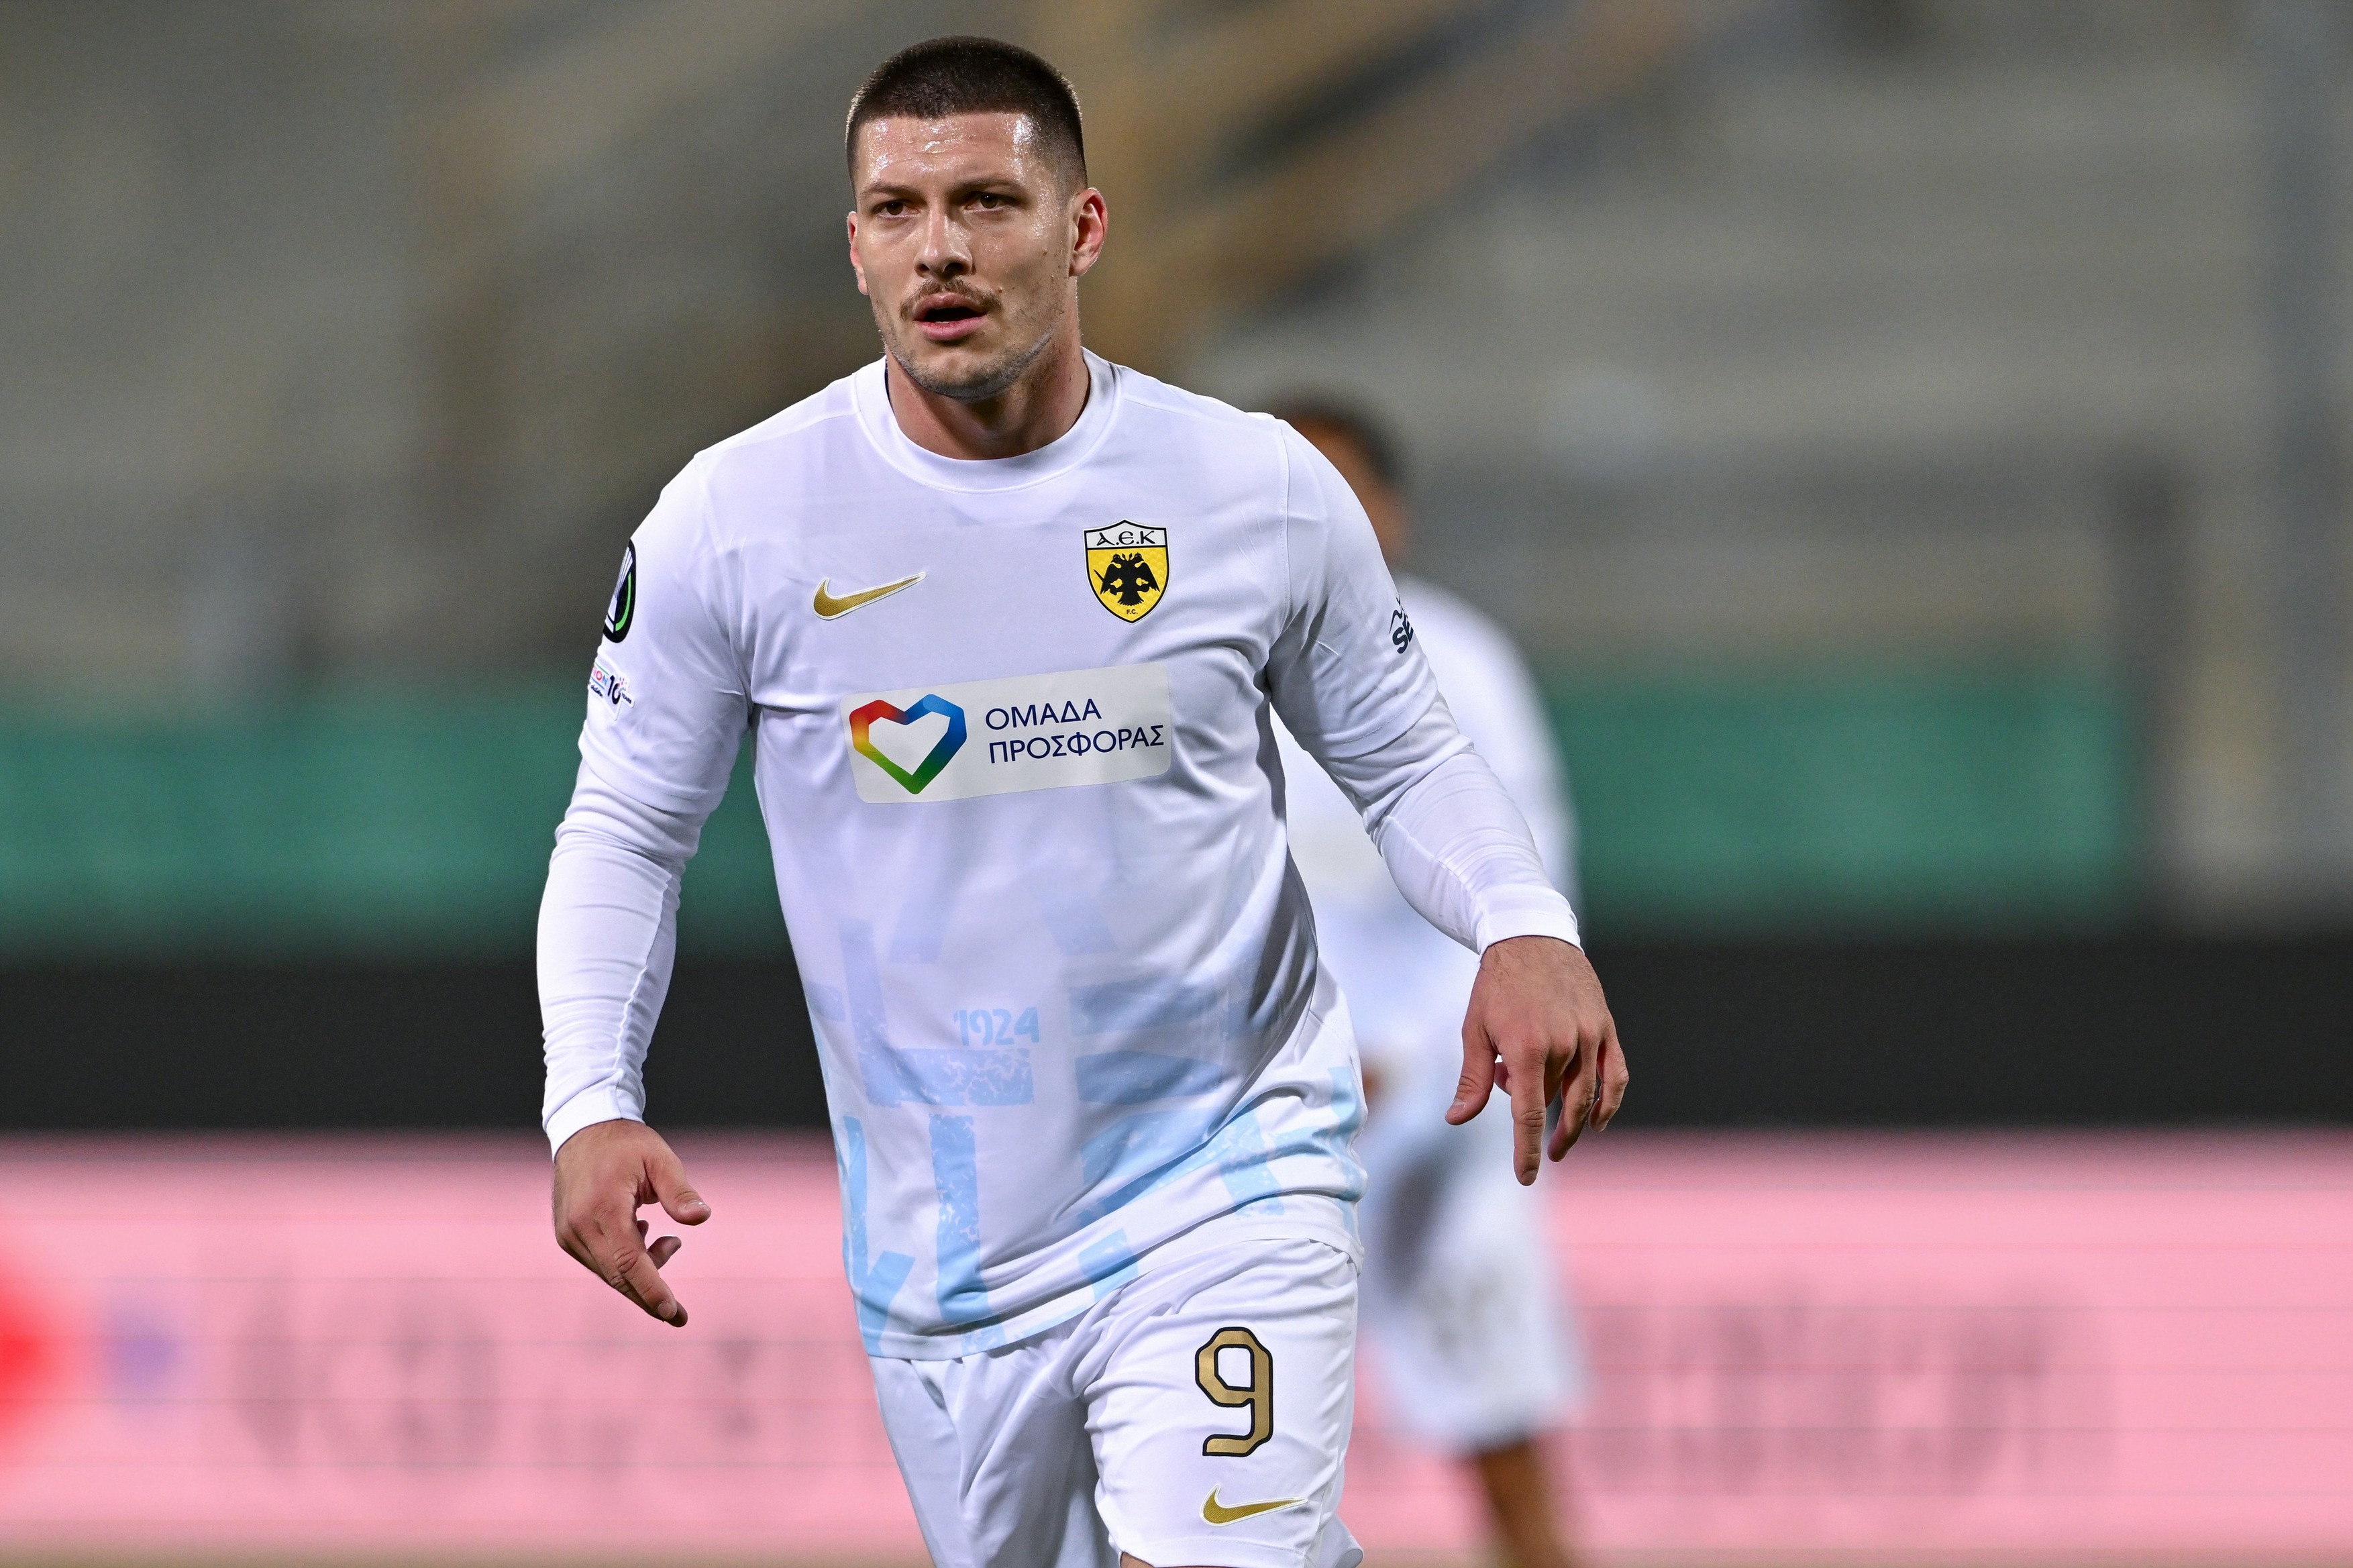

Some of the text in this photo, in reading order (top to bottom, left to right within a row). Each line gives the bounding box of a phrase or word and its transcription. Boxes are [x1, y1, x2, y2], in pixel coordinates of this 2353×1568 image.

[985, 698, 1102, 730] ΟΜΑΔΑ
[989, 725, 1164, 764] ΠΡΟΣΦΟΡΑΣ
[953, 1007, 1040, 1046] 1924
[1195, 1326, 1273, 1457] 9
